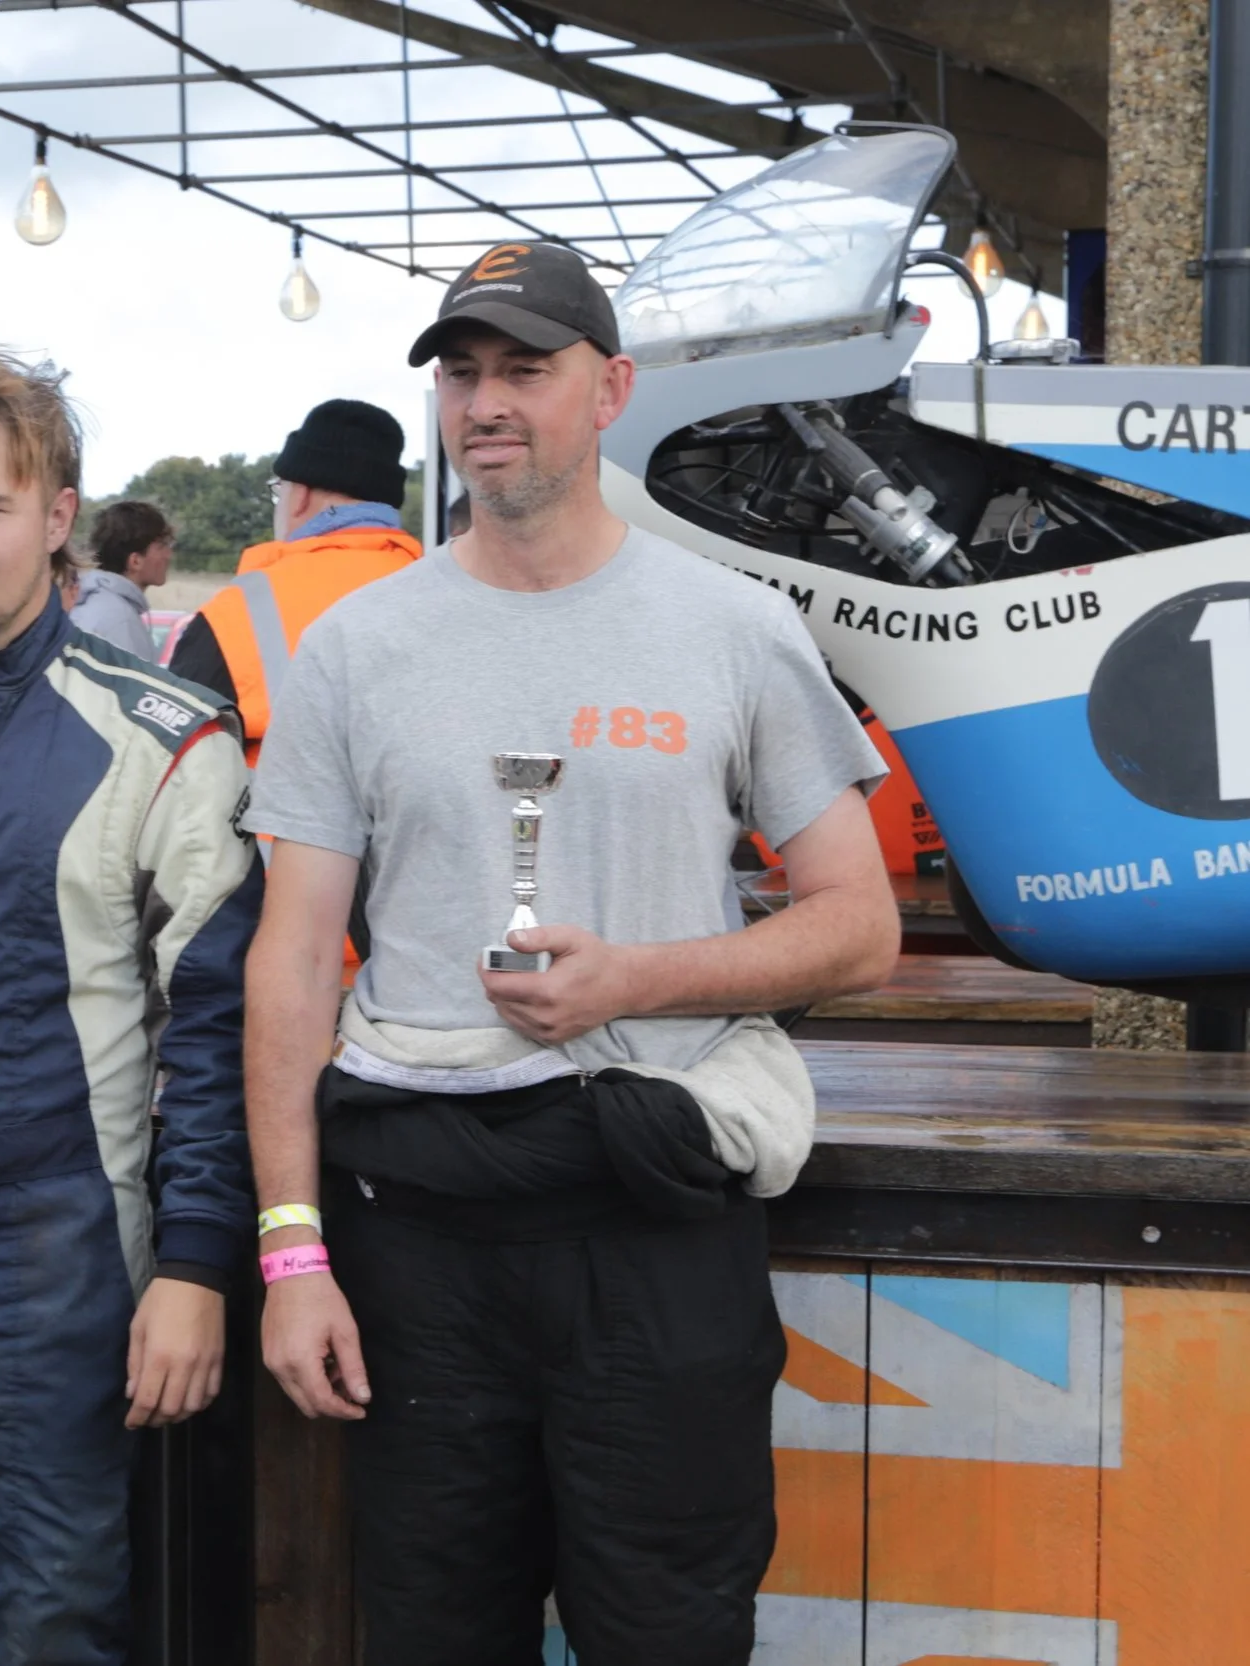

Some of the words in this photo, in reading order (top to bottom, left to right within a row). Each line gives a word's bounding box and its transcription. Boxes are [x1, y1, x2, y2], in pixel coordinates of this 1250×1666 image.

[1117, 400, 1250, 454] CAR
[833, 597, 978, 642] RACING
[1005, 590, 1101, 632] CLUB
[135, 695, 191, 730] OMP
[569, 706, 688, 755] #83
[1016, 858, 1172, 902] FORMULA
